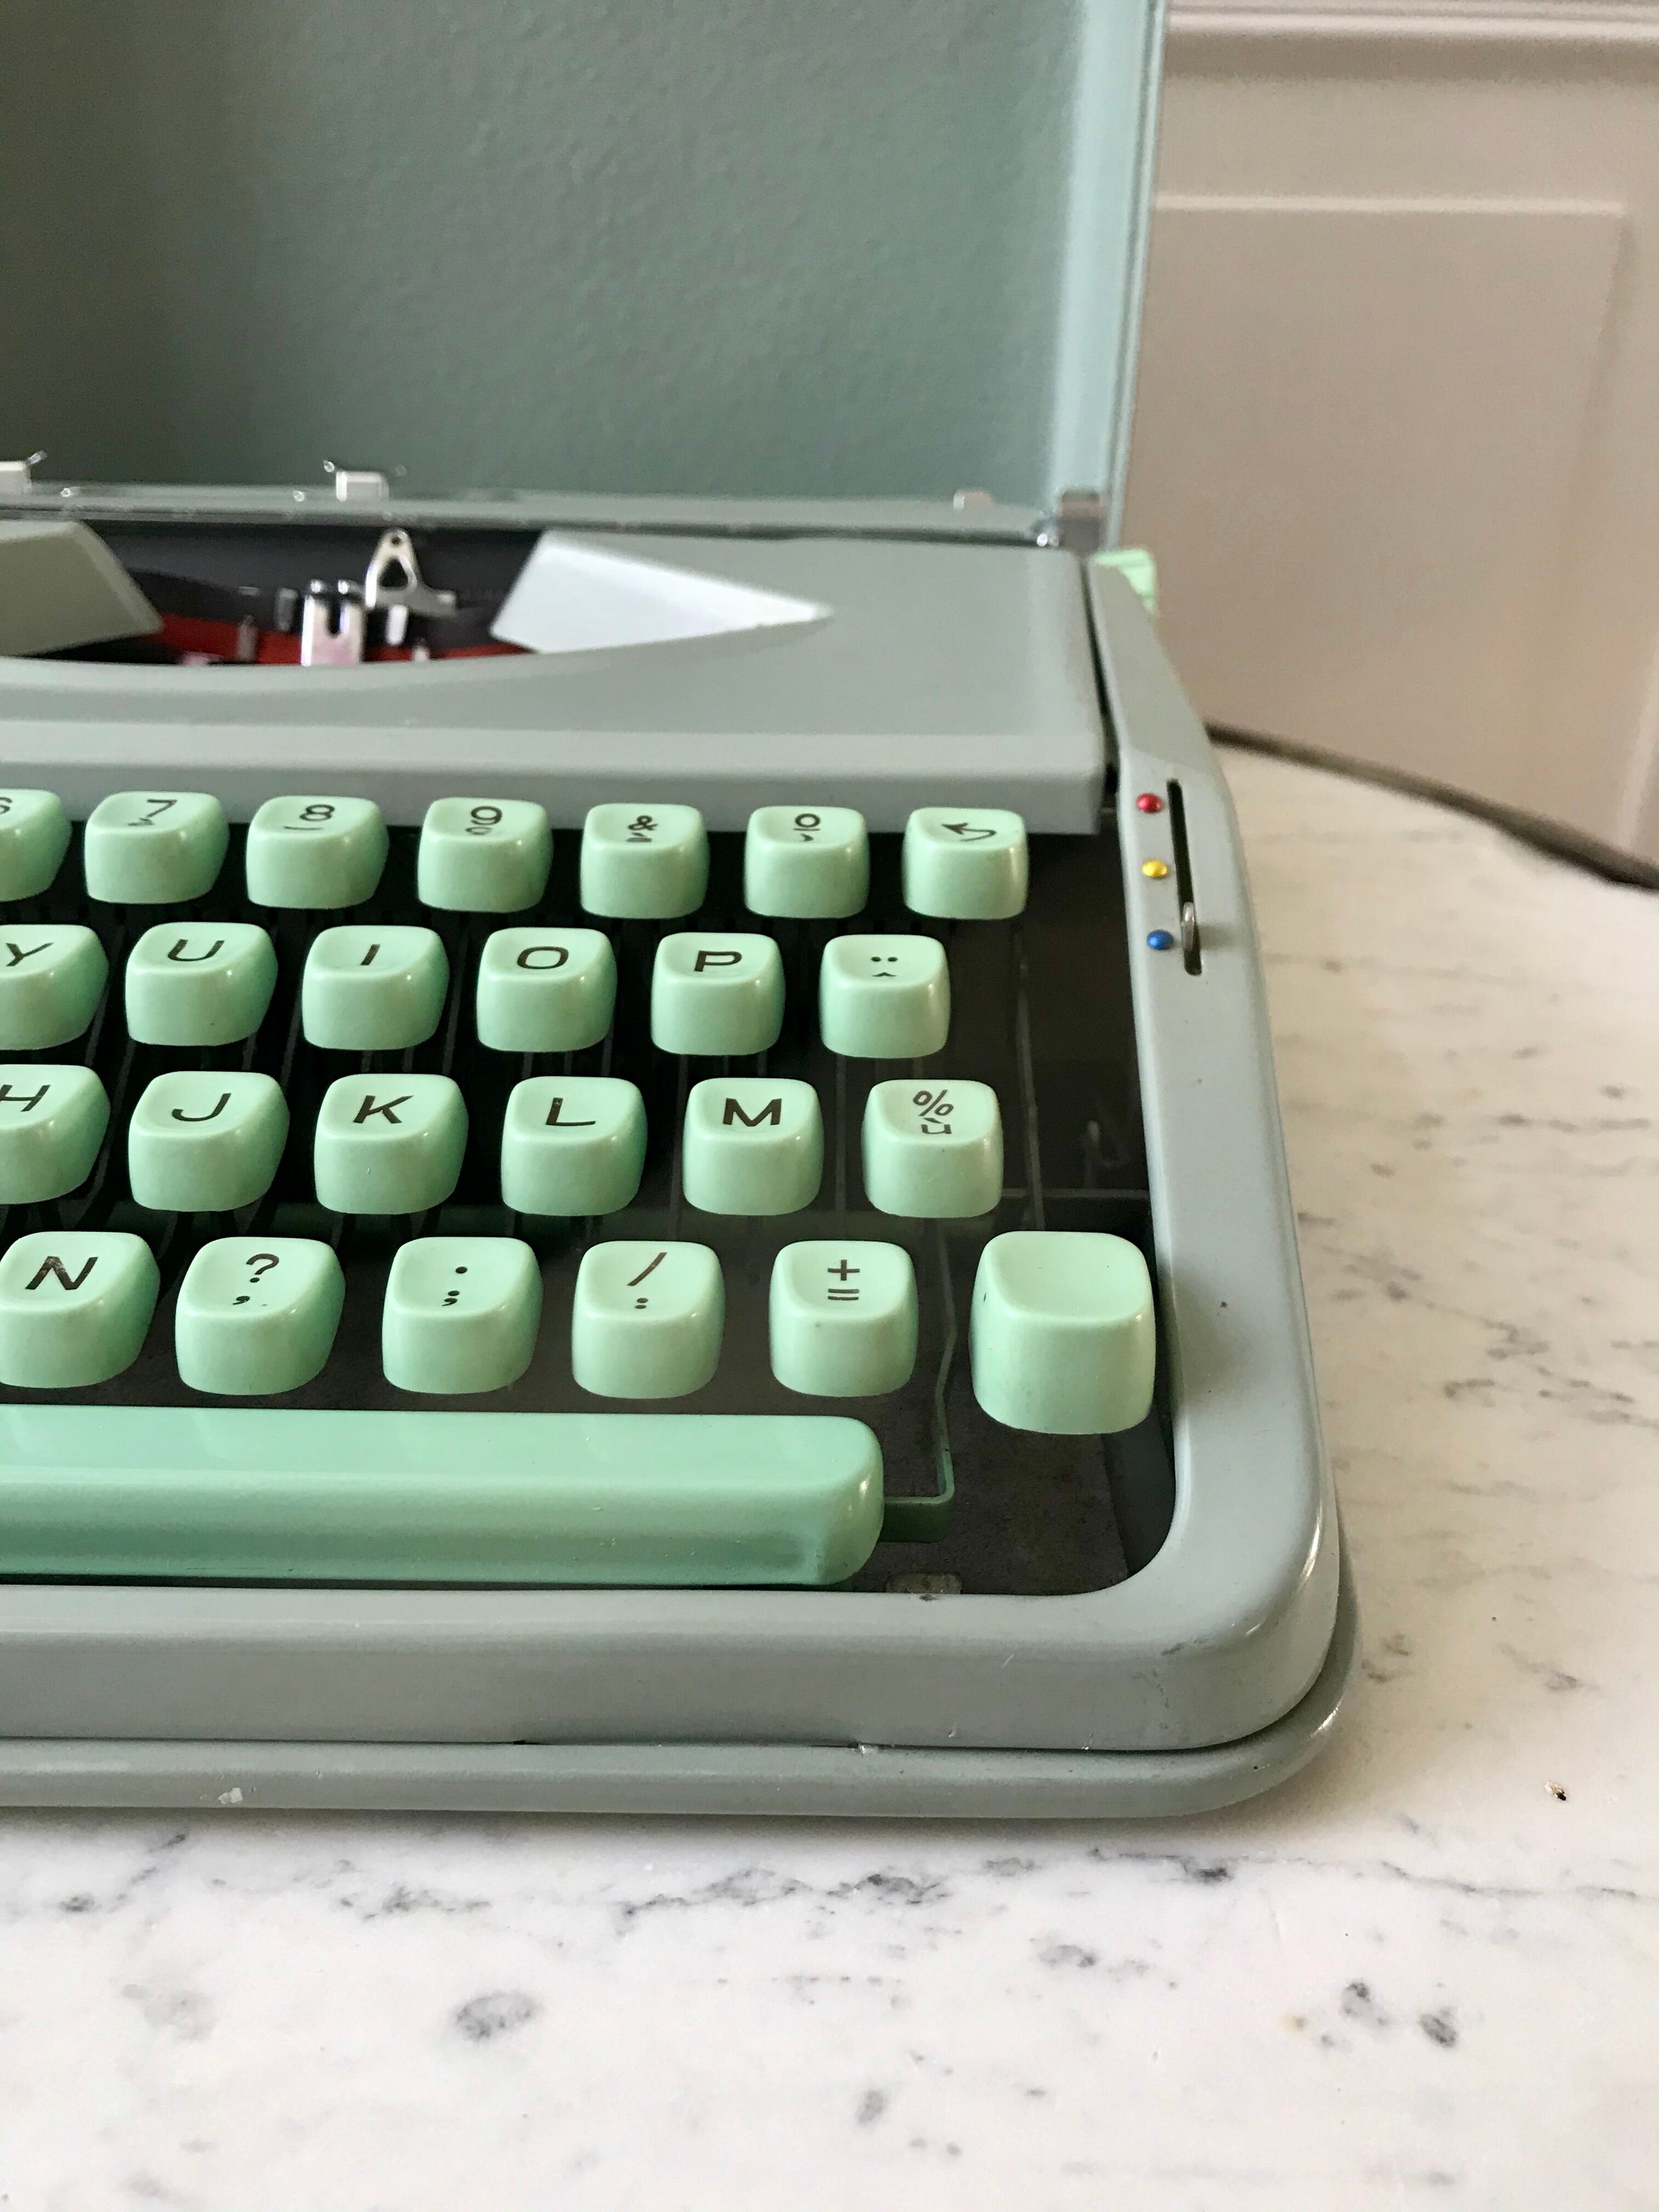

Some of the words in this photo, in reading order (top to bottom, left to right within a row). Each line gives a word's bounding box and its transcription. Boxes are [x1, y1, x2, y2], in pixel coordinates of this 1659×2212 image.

[146, 799, 178, 817] 7
[299, 804, 335, 822] 8
[470, 805, 503, 826] 9
[628, 815, 658, 831] &
[5, 942, 54, 967] Y
[167, 938, 225, 962] U
[359, 944, 381, 966] I
[516, 946, 569, 970] O
[693, 950, 743, 972] P
[0, 1084, 51, 1112] H
[171, 1092, 232, 1122] J
[353, 1094, 414, 1124] K
[912, 1090, 954, 1117] %
[545, 1097, 596, 1127] L
[723, 1097, 782, 1127] M
[25, 1255, 99, 1290] N
[246, 1253, 280, 1283] ?
[827, 1259, 860, 1282] +
